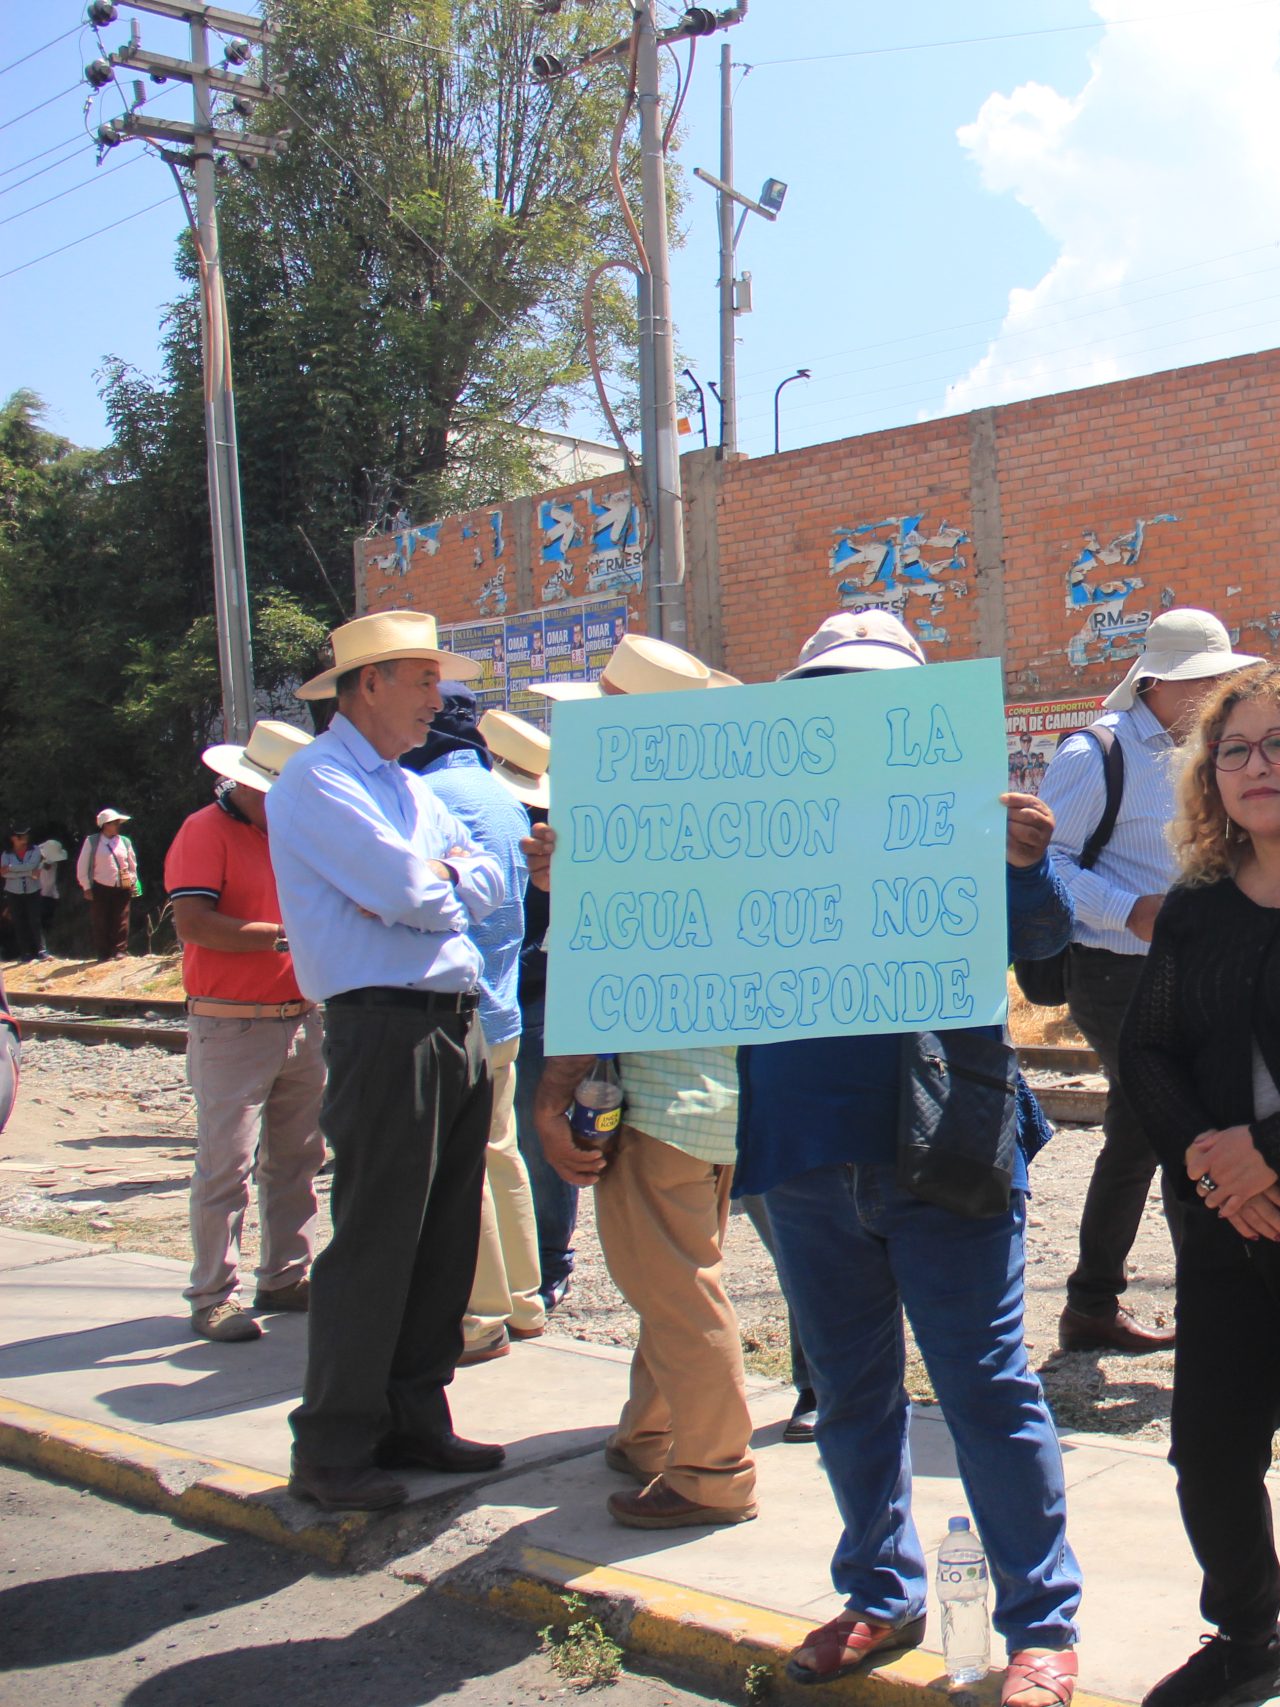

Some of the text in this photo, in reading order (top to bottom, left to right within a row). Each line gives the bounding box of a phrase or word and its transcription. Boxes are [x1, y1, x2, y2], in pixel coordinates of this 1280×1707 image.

[547, 629, 569, 645] OMAR
[587, 623, 610, 639] OMAR
[1008, 701, 1096, 716] COMPLEJO DEPORTIVO
[1029, 715, 1043, 731] DE
[596, 704, 962, 782] PEDIMOS LA
[570, 792, 956, 862] DOTACION DE
[570, 876, 978, 951] AGUA QUE NOS
[589, 958, 974, 1033] CORRESPONDE
